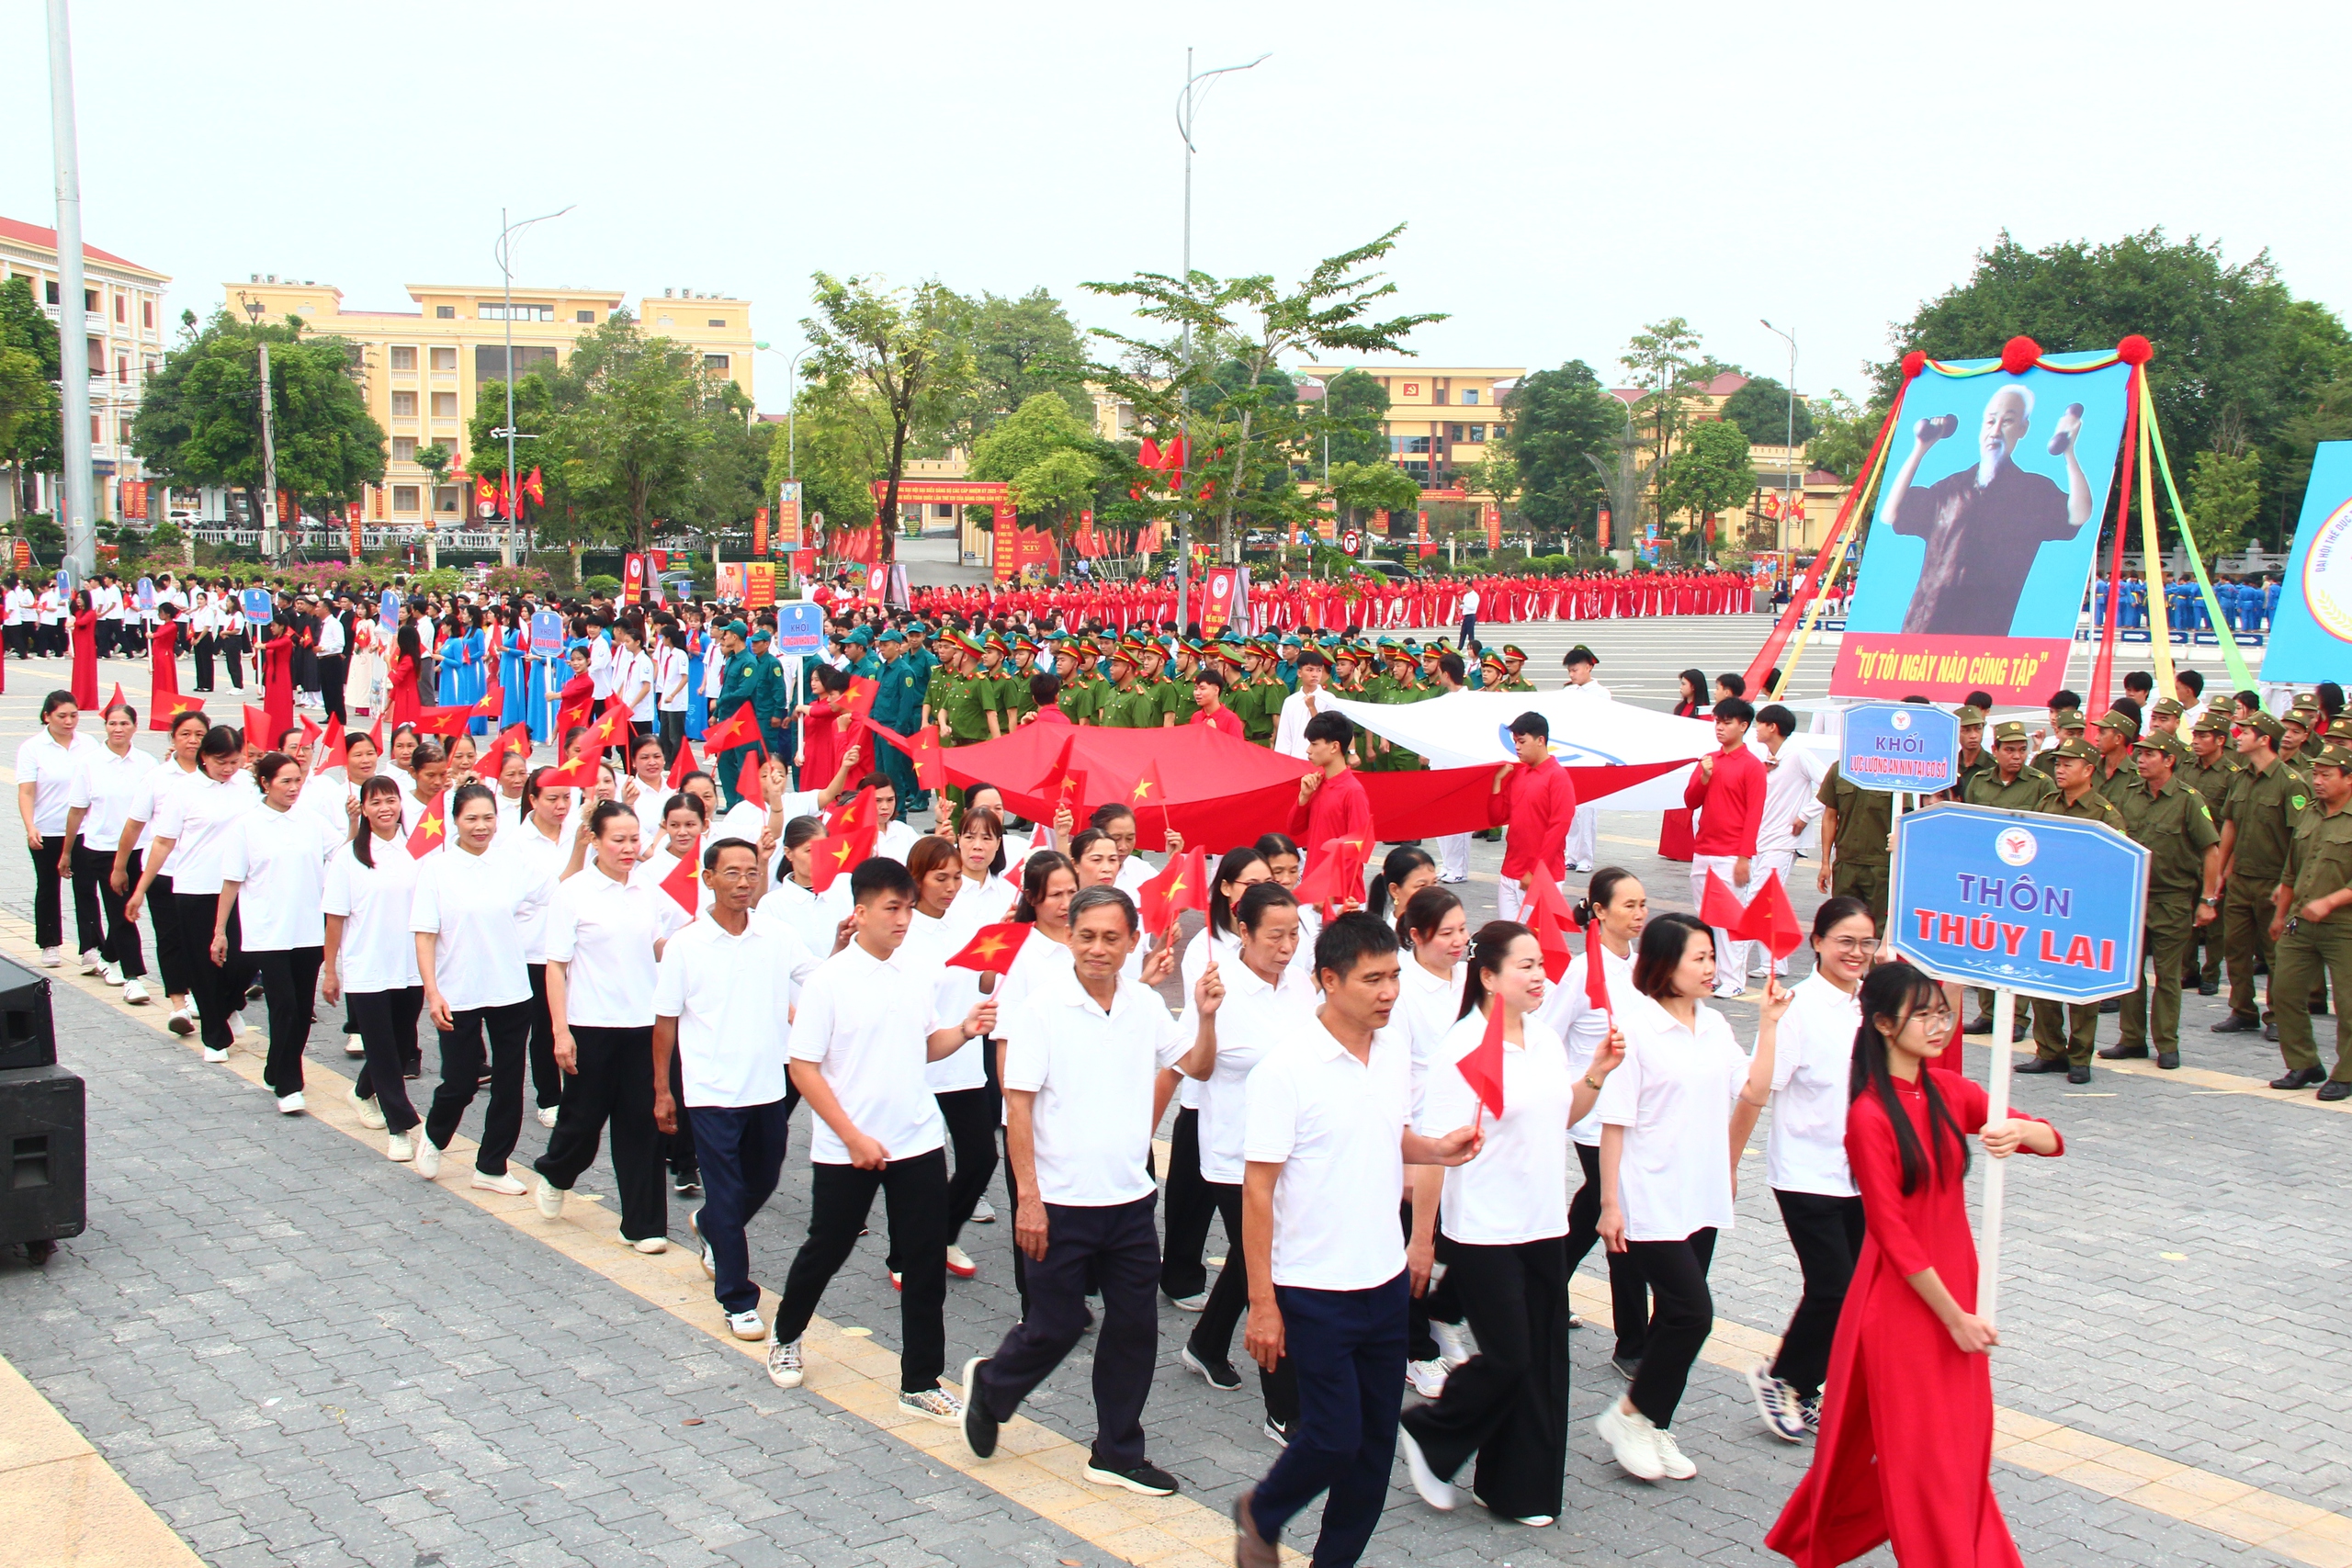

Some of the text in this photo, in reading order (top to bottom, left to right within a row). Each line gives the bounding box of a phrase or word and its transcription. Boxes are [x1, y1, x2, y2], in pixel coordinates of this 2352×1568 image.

[2318, 545, 2333, 558] HỘI
[2335, 515, 2352, 531] DỤC
[791, 620, 809, 632] KHỐI
[1876, 648, 1899, 680] TÔI
[1898, 650, 1938, 682] NGÀY
[1936, 651, 1968, 684] NÀO
[1968, 652, 2008, 685] CŨNG
[1876, 732, 1924, 753] KHỐI
[1850, 755, 1863, 775] LỰC
[1865, 755, 1888, 776] LƯỢNG
[1889, 758, 1900, 775] AN
[1914, 761, 1925, 780] TẠI
[1926, 761, 1936, 778] CƠ
[1936, 757, 1947, 778] SỞ
[1957, 872, 2073, 918] THÔN
[1914, 908, 2115, 972] THÚY LAI
